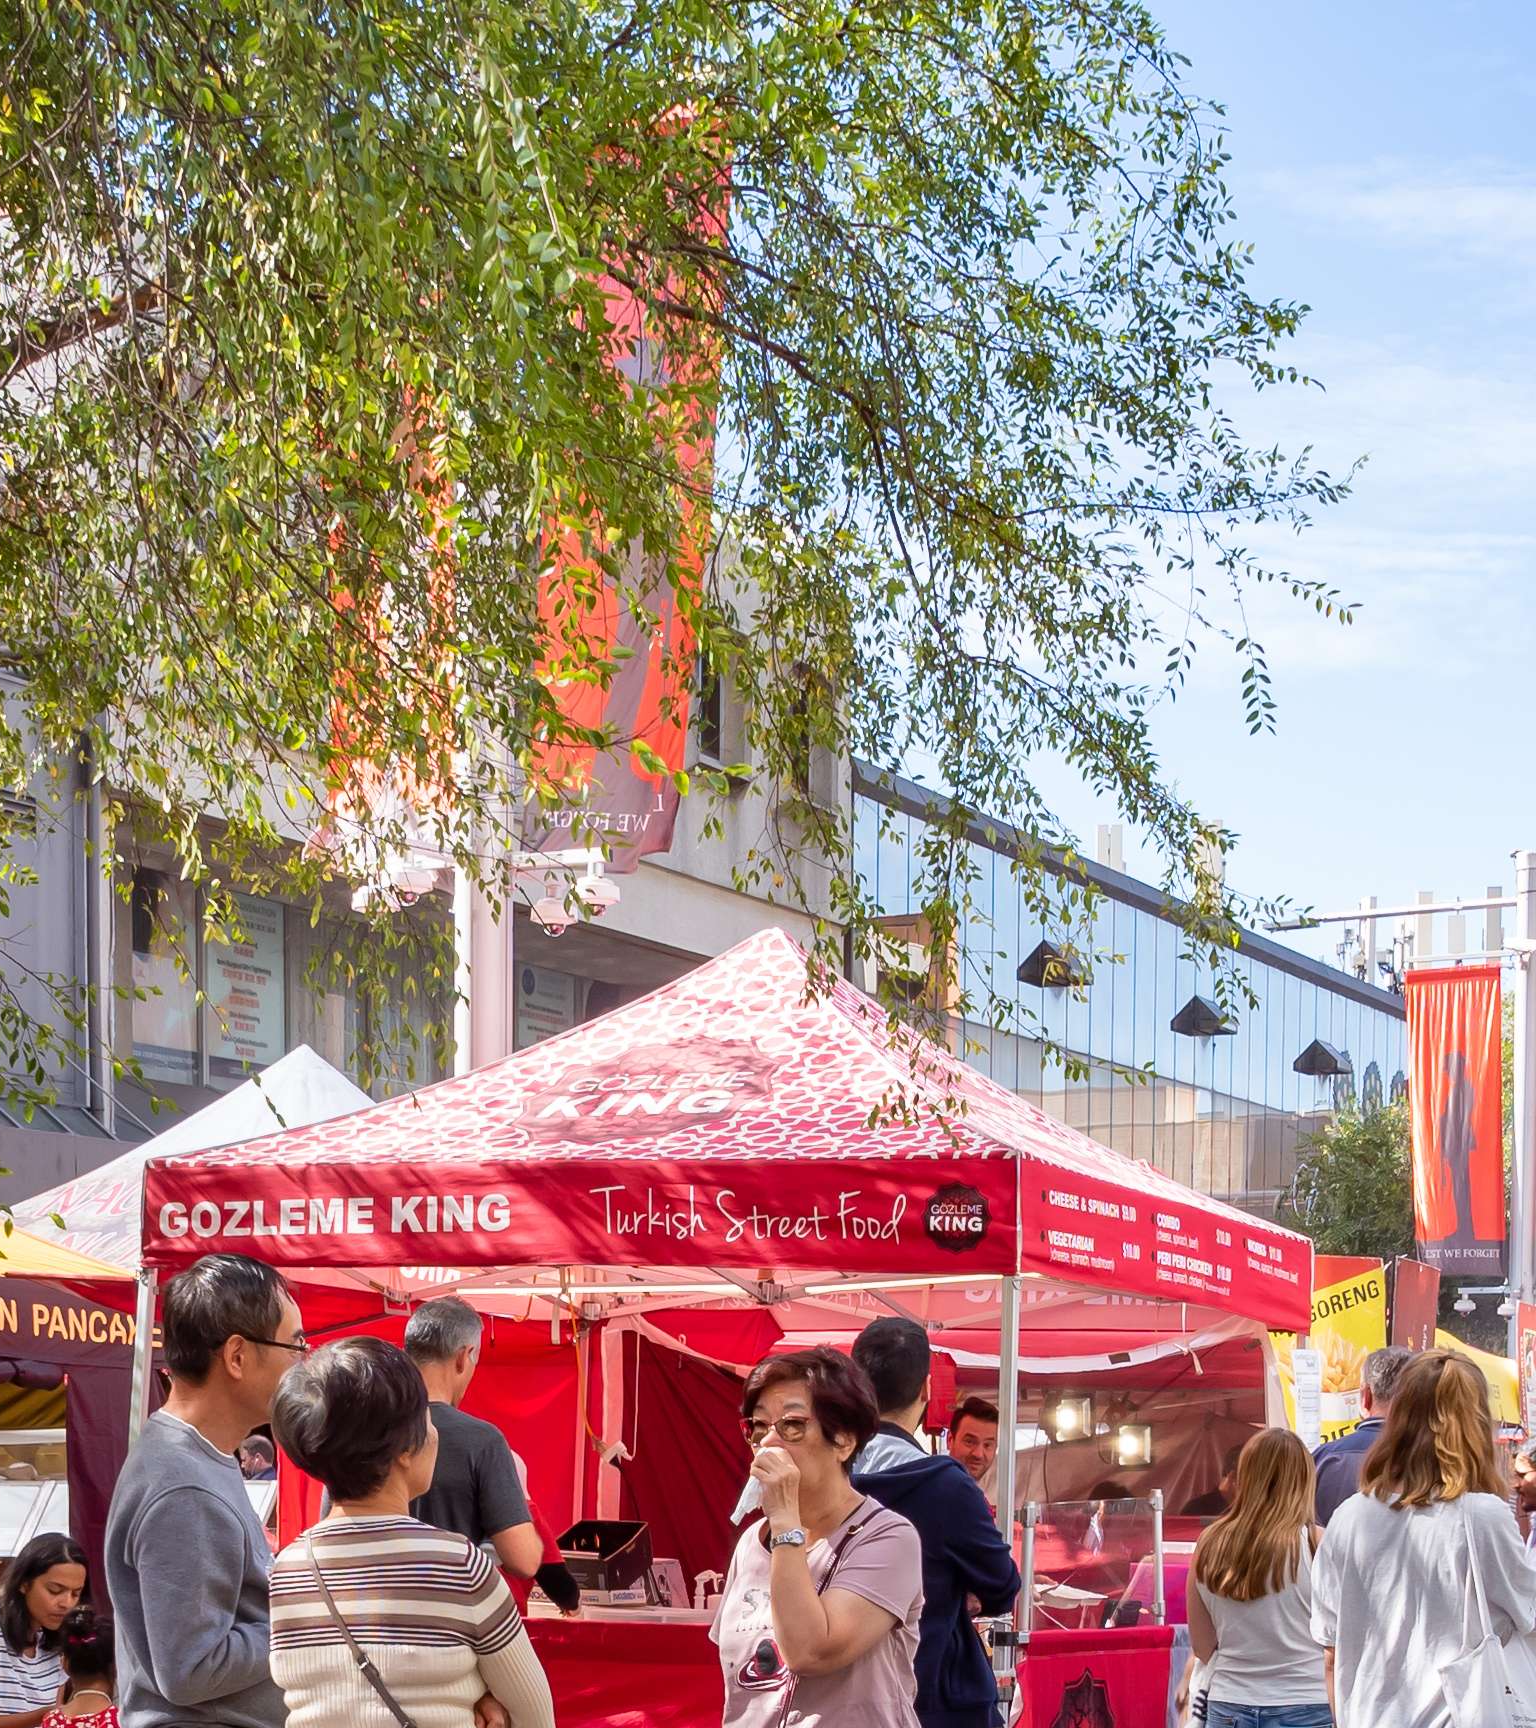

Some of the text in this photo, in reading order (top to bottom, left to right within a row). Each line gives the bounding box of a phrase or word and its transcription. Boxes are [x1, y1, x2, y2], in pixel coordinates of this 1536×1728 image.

[569, 1069, 756, 1094] GÖZLEME
[538, 1089, 739, 1119] KING
[159, 1193, 512, 1238] GOZLEME KING
[590, 1185, 907, 1245] Turkish Street Food
[930, 1201, 983, 1216] GÖZLEME
[1049, 1190, 1080, 1211] CHEESE
[1080, 1196, 1087, 1213] &
[1088, 1199, 1120, 1219] SPINACH
[929, 1216, 983, 1233] KING
[1048, 1229, 1095, 1252] VEGETARIAN
[1424, 1249, 1441, 1259] EST
[1444, 1249, 1461, 1258] WE
